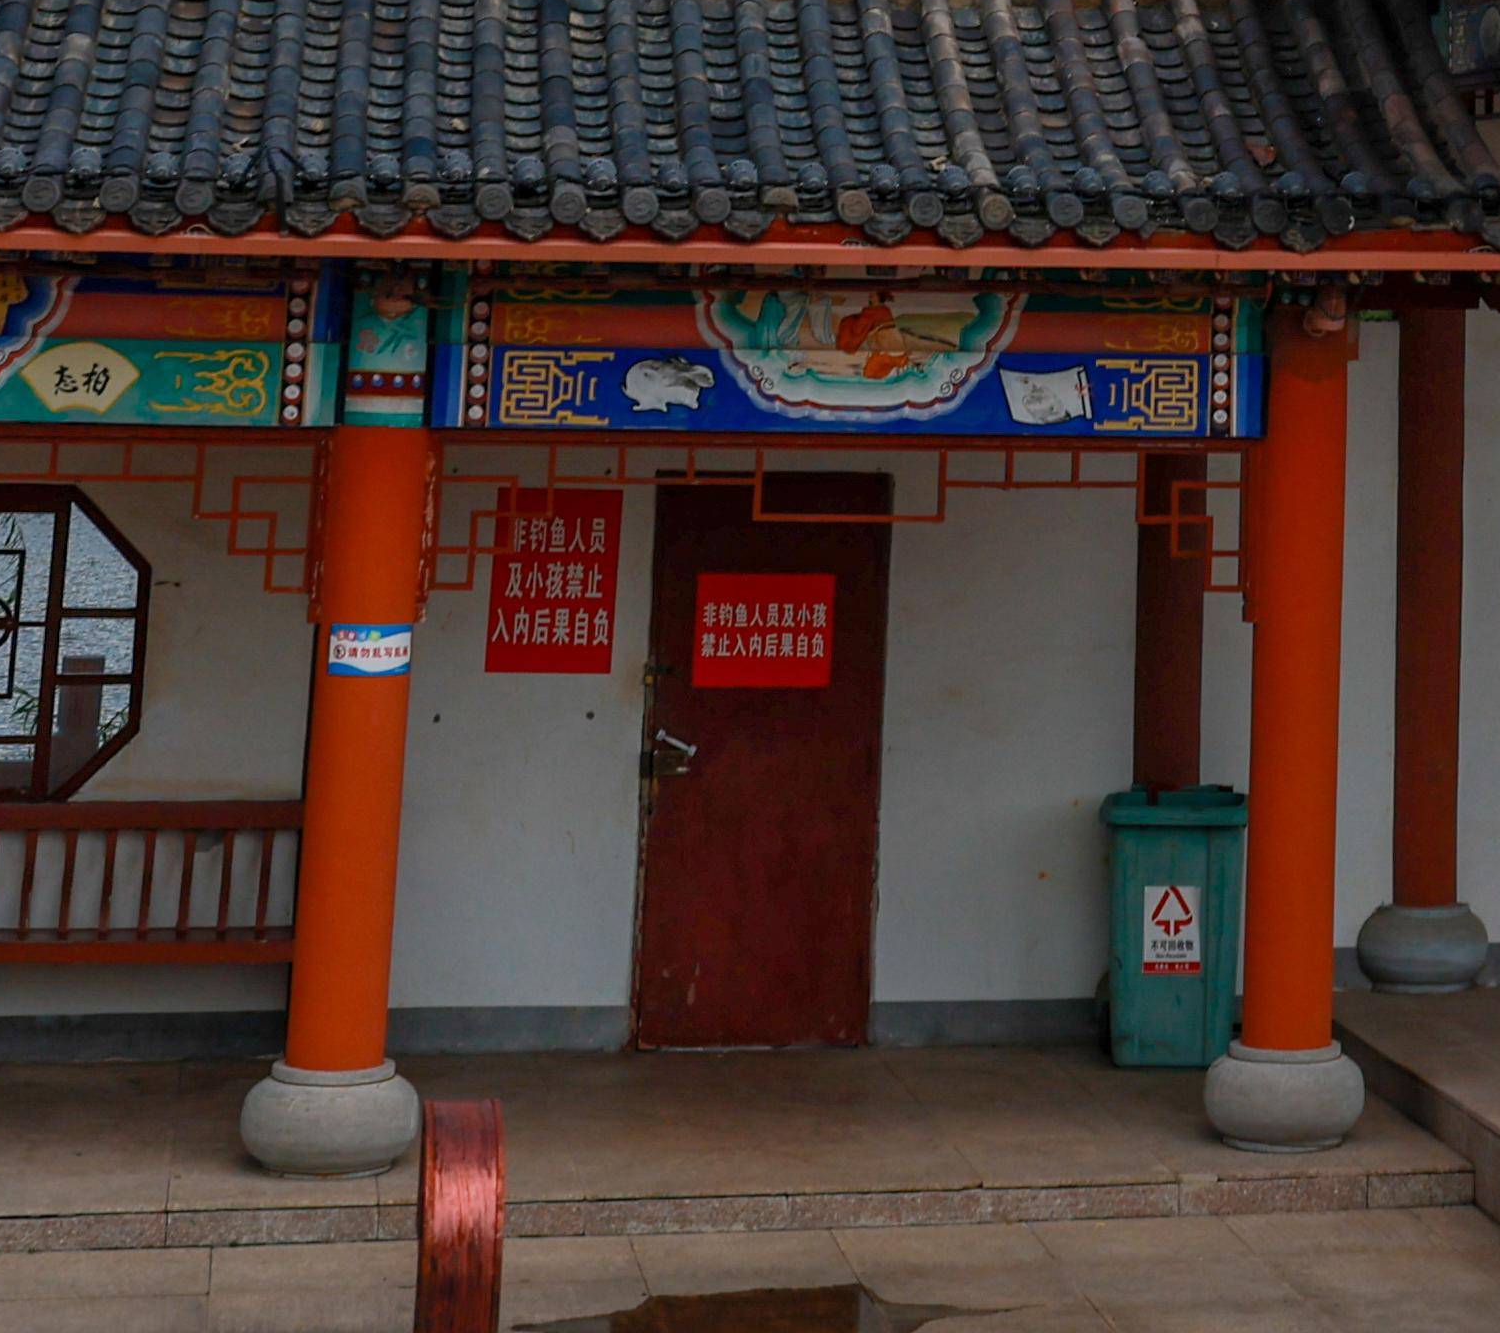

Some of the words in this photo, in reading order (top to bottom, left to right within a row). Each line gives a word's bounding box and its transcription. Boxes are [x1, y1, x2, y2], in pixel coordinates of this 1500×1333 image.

[513, 517, 606, 553] 非钓鱼人员
[504, 561, 603, 599] 及小孩禁止
[491, 606, 609, 645] 入内后果自负
[702, 602, 827, 628] 非钓鱼人员及小孩
[701, 633, 825, 658] 禁止入内后果自负
